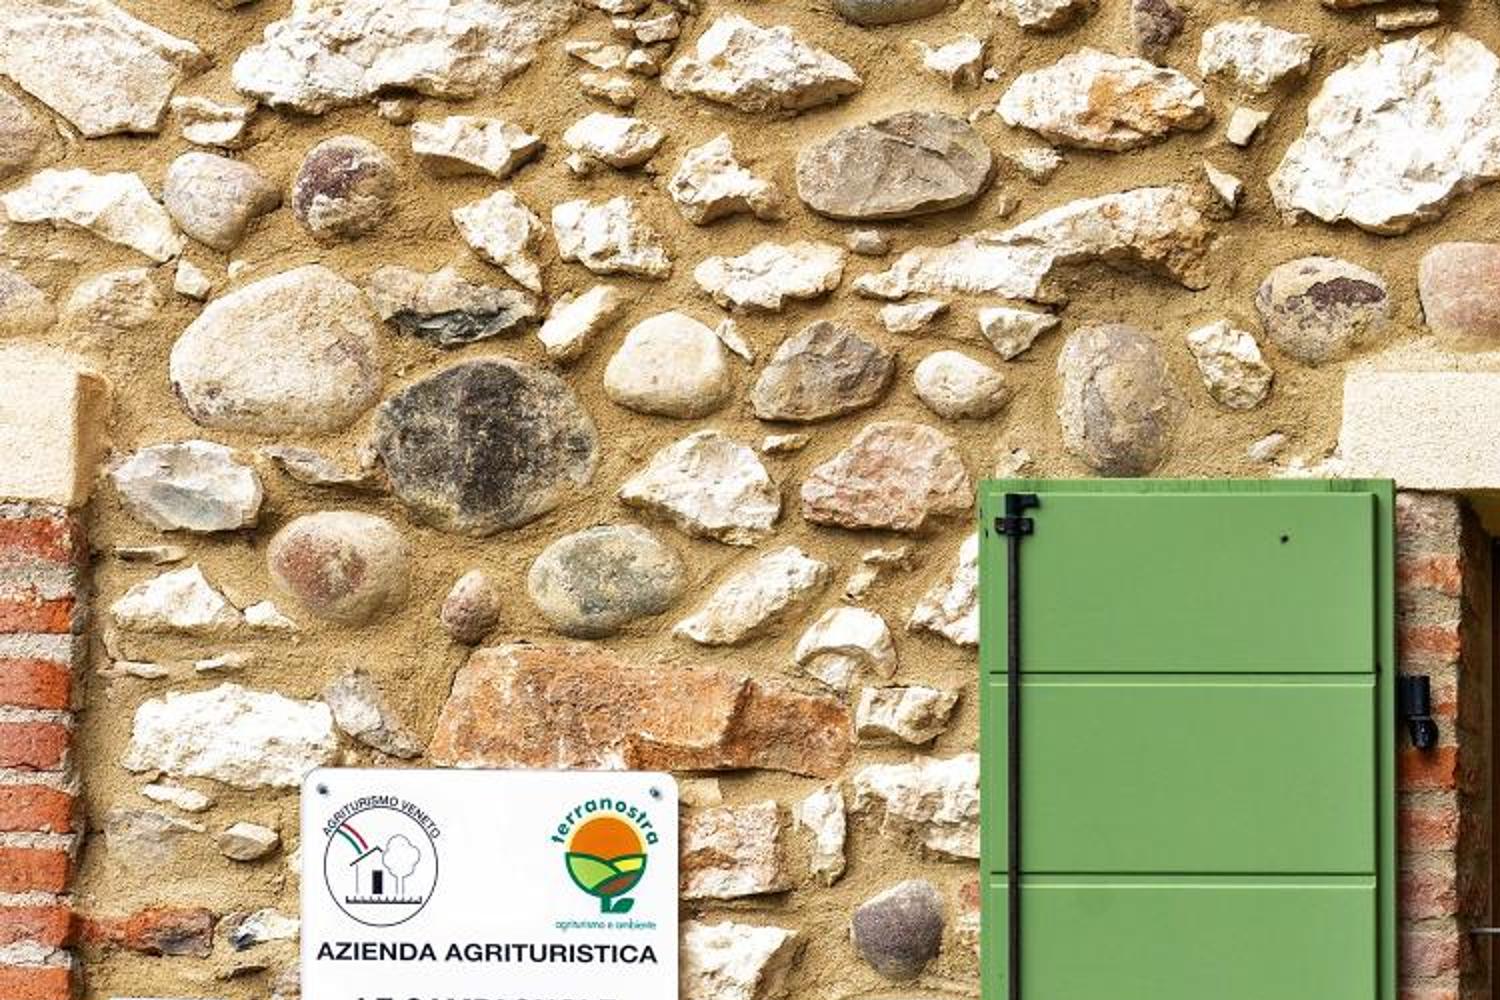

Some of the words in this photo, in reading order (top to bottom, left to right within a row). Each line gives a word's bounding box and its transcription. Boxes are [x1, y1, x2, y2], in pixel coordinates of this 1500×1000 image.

[323, 795, 399, 837] AGRITURISMO
[402, 800, 441, 840] VENETO
[551, 797, 659, 845] terranostra
[555, 920, 606, 932] agriturismo
[615, 918, 657, 930] ambiente
[316, 941, 437, 962] AZIENDA
[444, 943, 658, 964] AGRITURISTICA
